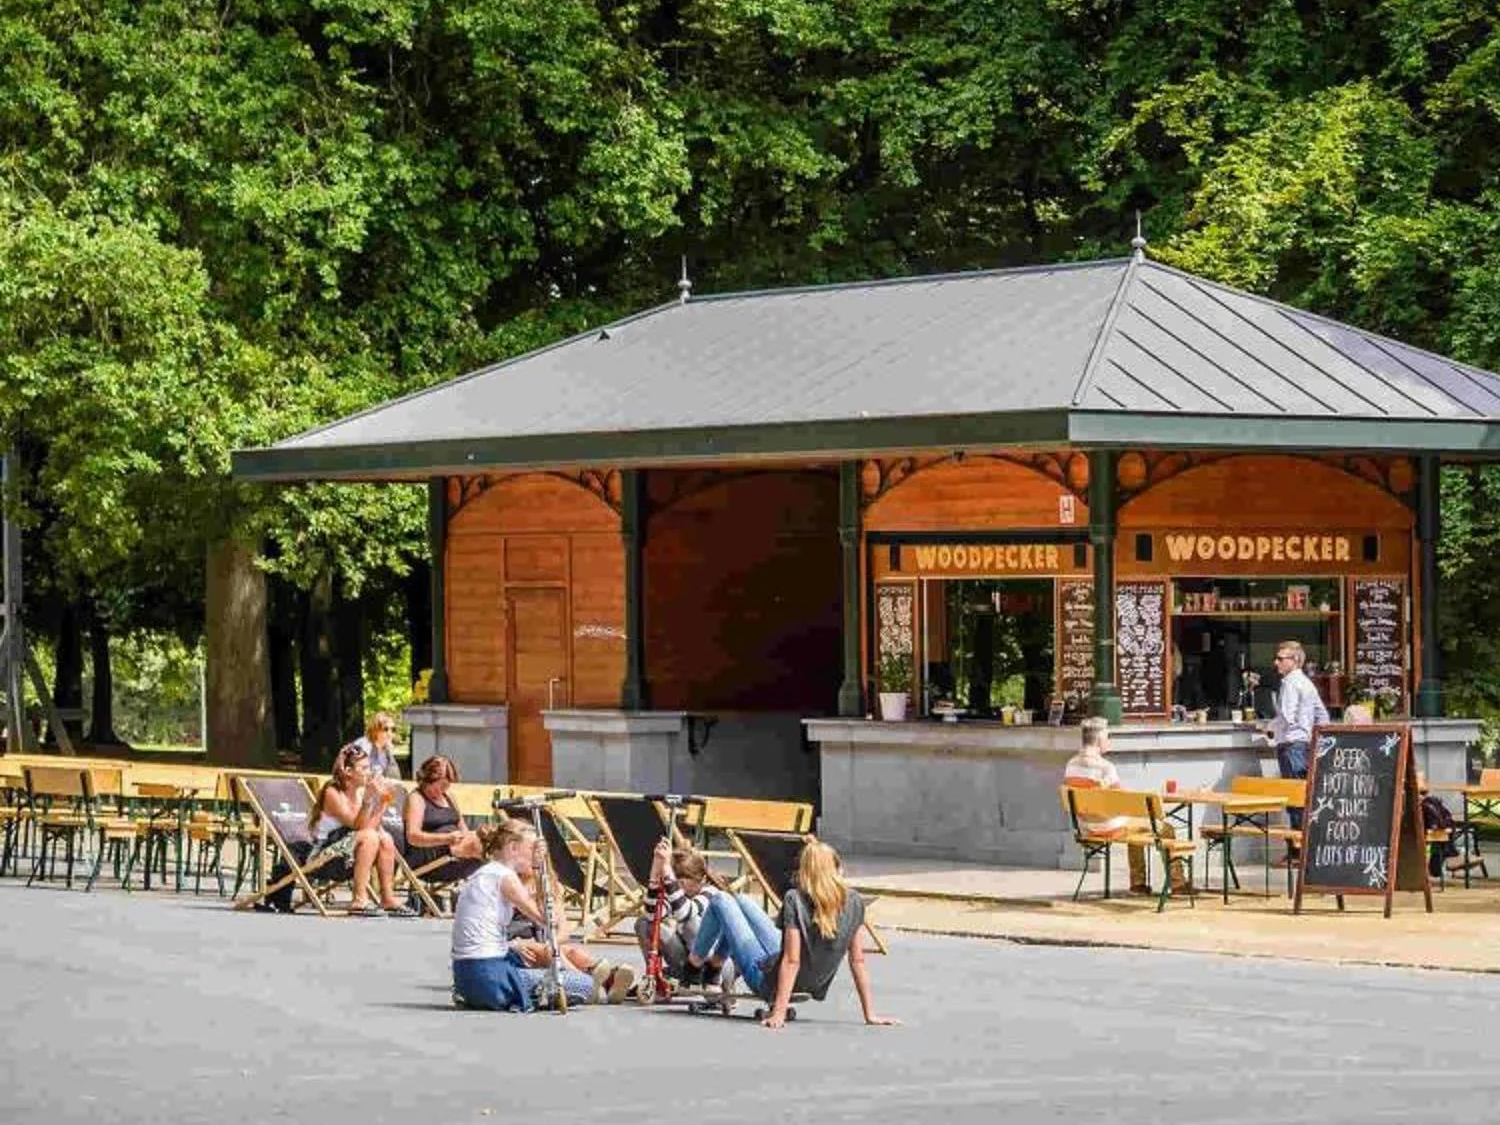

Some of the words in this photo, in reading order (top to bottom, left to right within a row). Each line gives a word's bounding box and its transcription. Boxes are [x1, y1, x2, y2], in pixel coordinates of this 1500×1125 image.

[915, 544, 1060, 570] WOODPECKER
[1165, 534, 1351, 562] WOODPECKER
[1323, 773, 1347, 795] HOT
[1337, 798, 1370, 818] JUICE
[1326, 820, 1361, 842] FOOD
[1315, 845, 1342, 867] LOTS
[1345, 845, 1358, 865] OF
